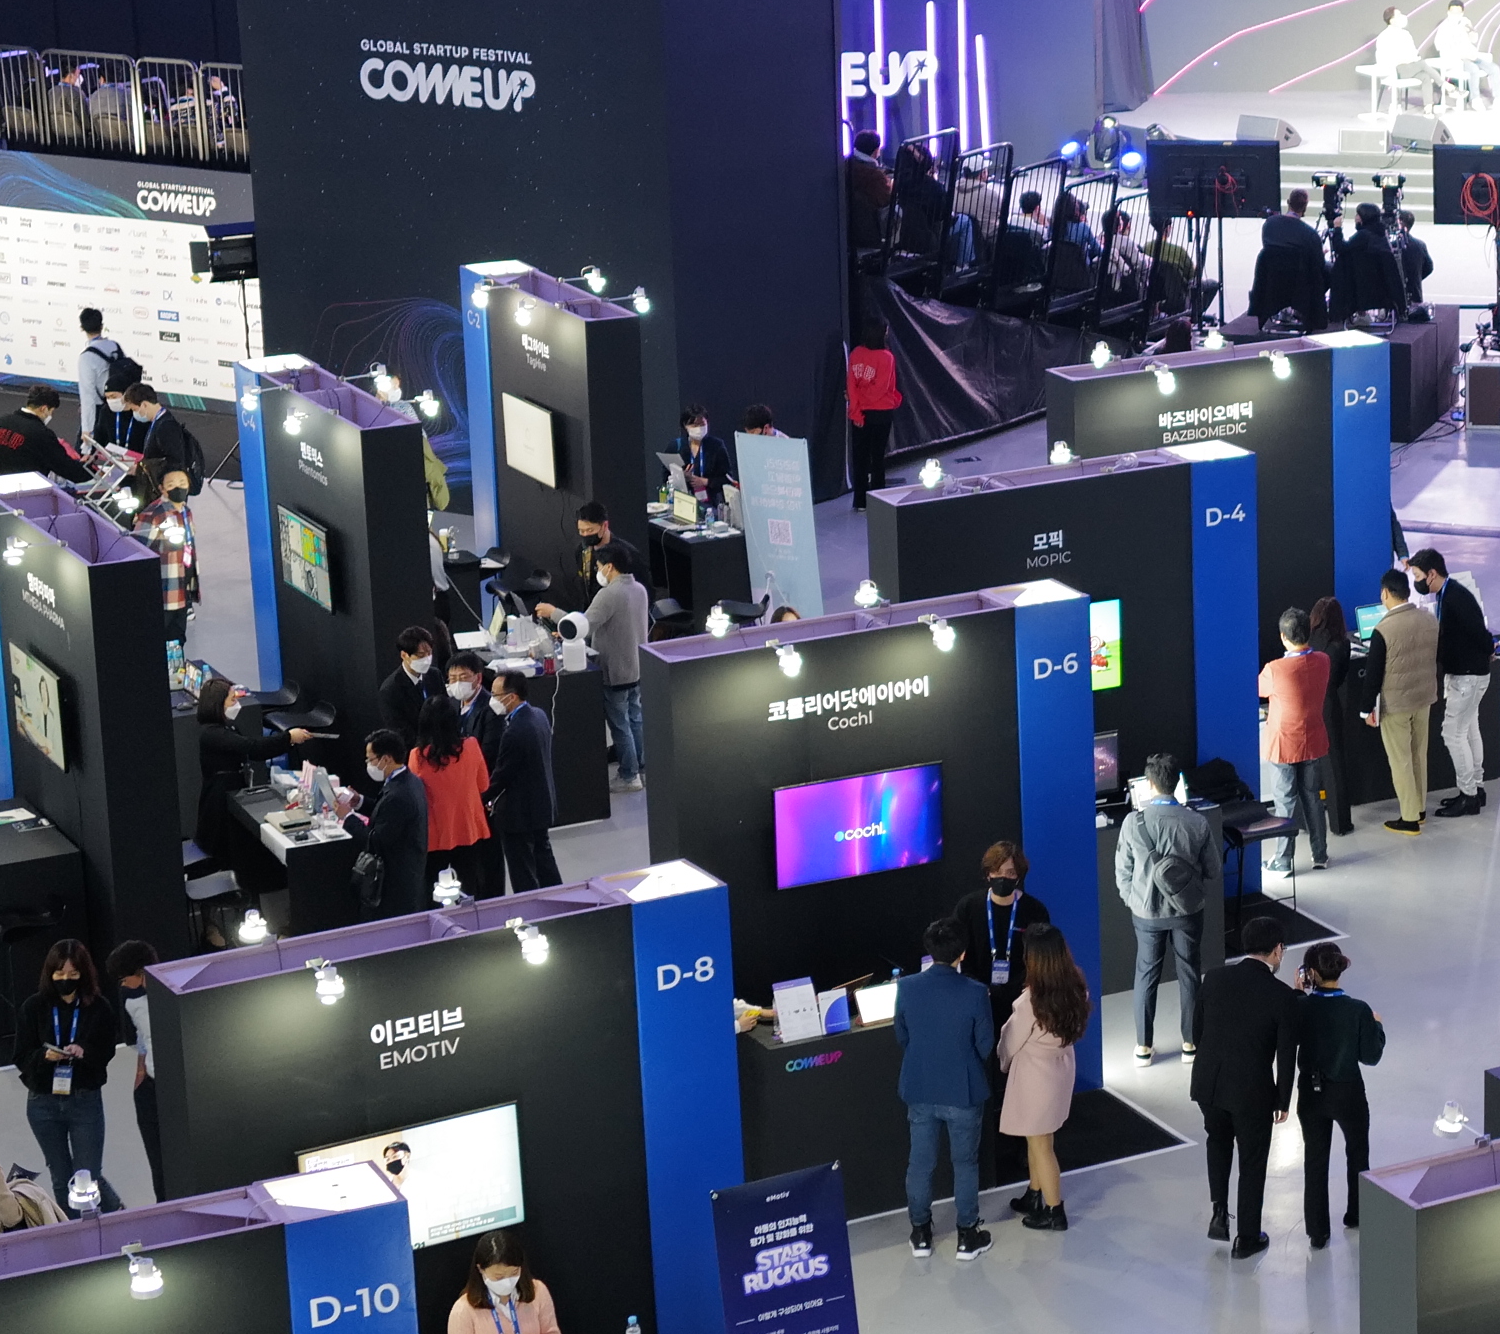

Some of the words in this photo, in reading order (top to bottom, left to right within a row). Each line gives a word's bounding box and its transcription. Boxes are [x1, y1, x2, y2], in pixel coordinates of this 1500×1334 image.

[360, 38, 409, 55] GLOBAL
[413, 41, 468, 60] STARTUP
[472, 45, 532, 64] FESTIVAL
[360, 57, 536, 112] COMEUP
[137, 181, 160, 191] GLOBAL
[161, 182, 186, 193] STARTUP
[187, 184, 215, 195] FESTIVAL
[136, 189, 216, 217] COMEUP
[467, 309, 481, 329] C-2
[1343, 386, 1377, 409] D-2
[241, 408, 256, 432] C-4
[1161, 419, 1248, 445] BAZBIOMEDIC
[1205, 503, 1246, 529] D-4
[1032, 529, 1064, 552] 모픽
[1025, 549, 1072, 570] MOPIC
[1032, 652, 1079, 681] D-6
[767, 675, 930, 723] 코클리어닷에이아이
[827, 708, 873, 732] Cochl
[655, 956, 716, 993] D-8
[370, 1005, 466, 1047] 이모티브
[379, 1036, 460, 1071] EMOTIV
[785, 1050, 843, 1073] COMEUP
[756, 1241, 813, 1271] STAR
[743, 1255, 830, 1296] RUCKUS
[310, 1282, 400, 1329] D-10
